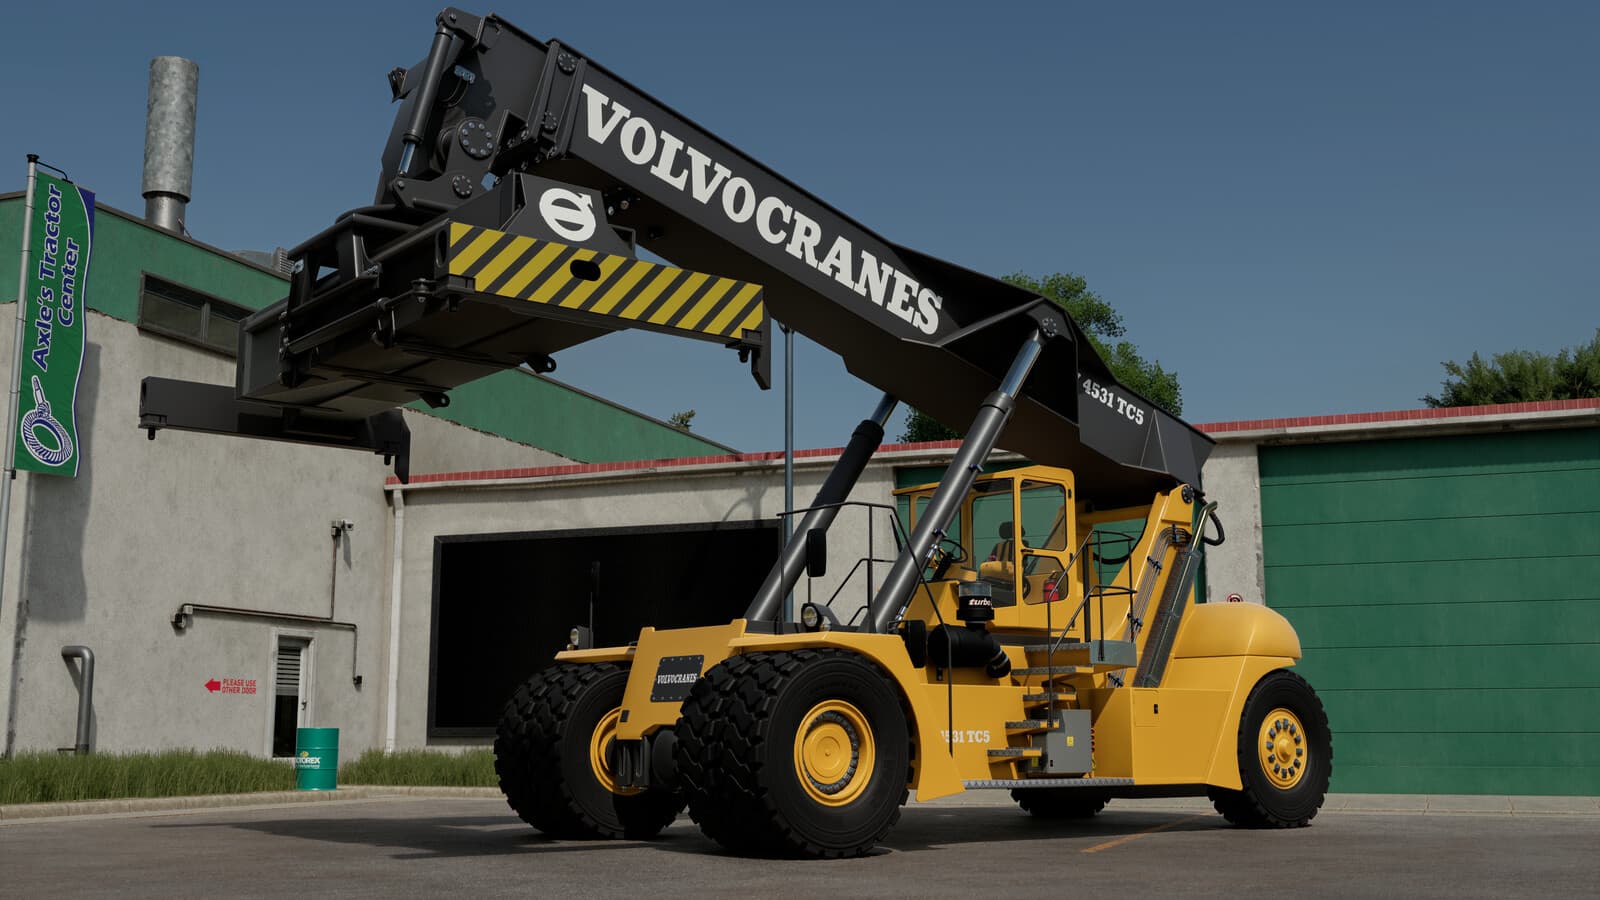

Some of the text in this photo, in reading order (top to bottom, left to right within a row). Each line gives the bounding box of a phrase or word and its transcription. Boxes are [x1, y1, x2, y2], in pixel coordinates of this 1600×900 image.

[582, 83, 942, 335] VOLVOCRANES
[32, 183, 62, 372] Axle's Tractor
[57, 237, 80, 327] Center
[1082, 379, 1144, 425] 4531 TC5
[222, 686, 256, 695] OTHER DOOR
[223, 678, 256, 687] PLEASE USE
[657, 673, 697, 684] VOLVOCRANES
[966, 730, 990, 743] TC5
